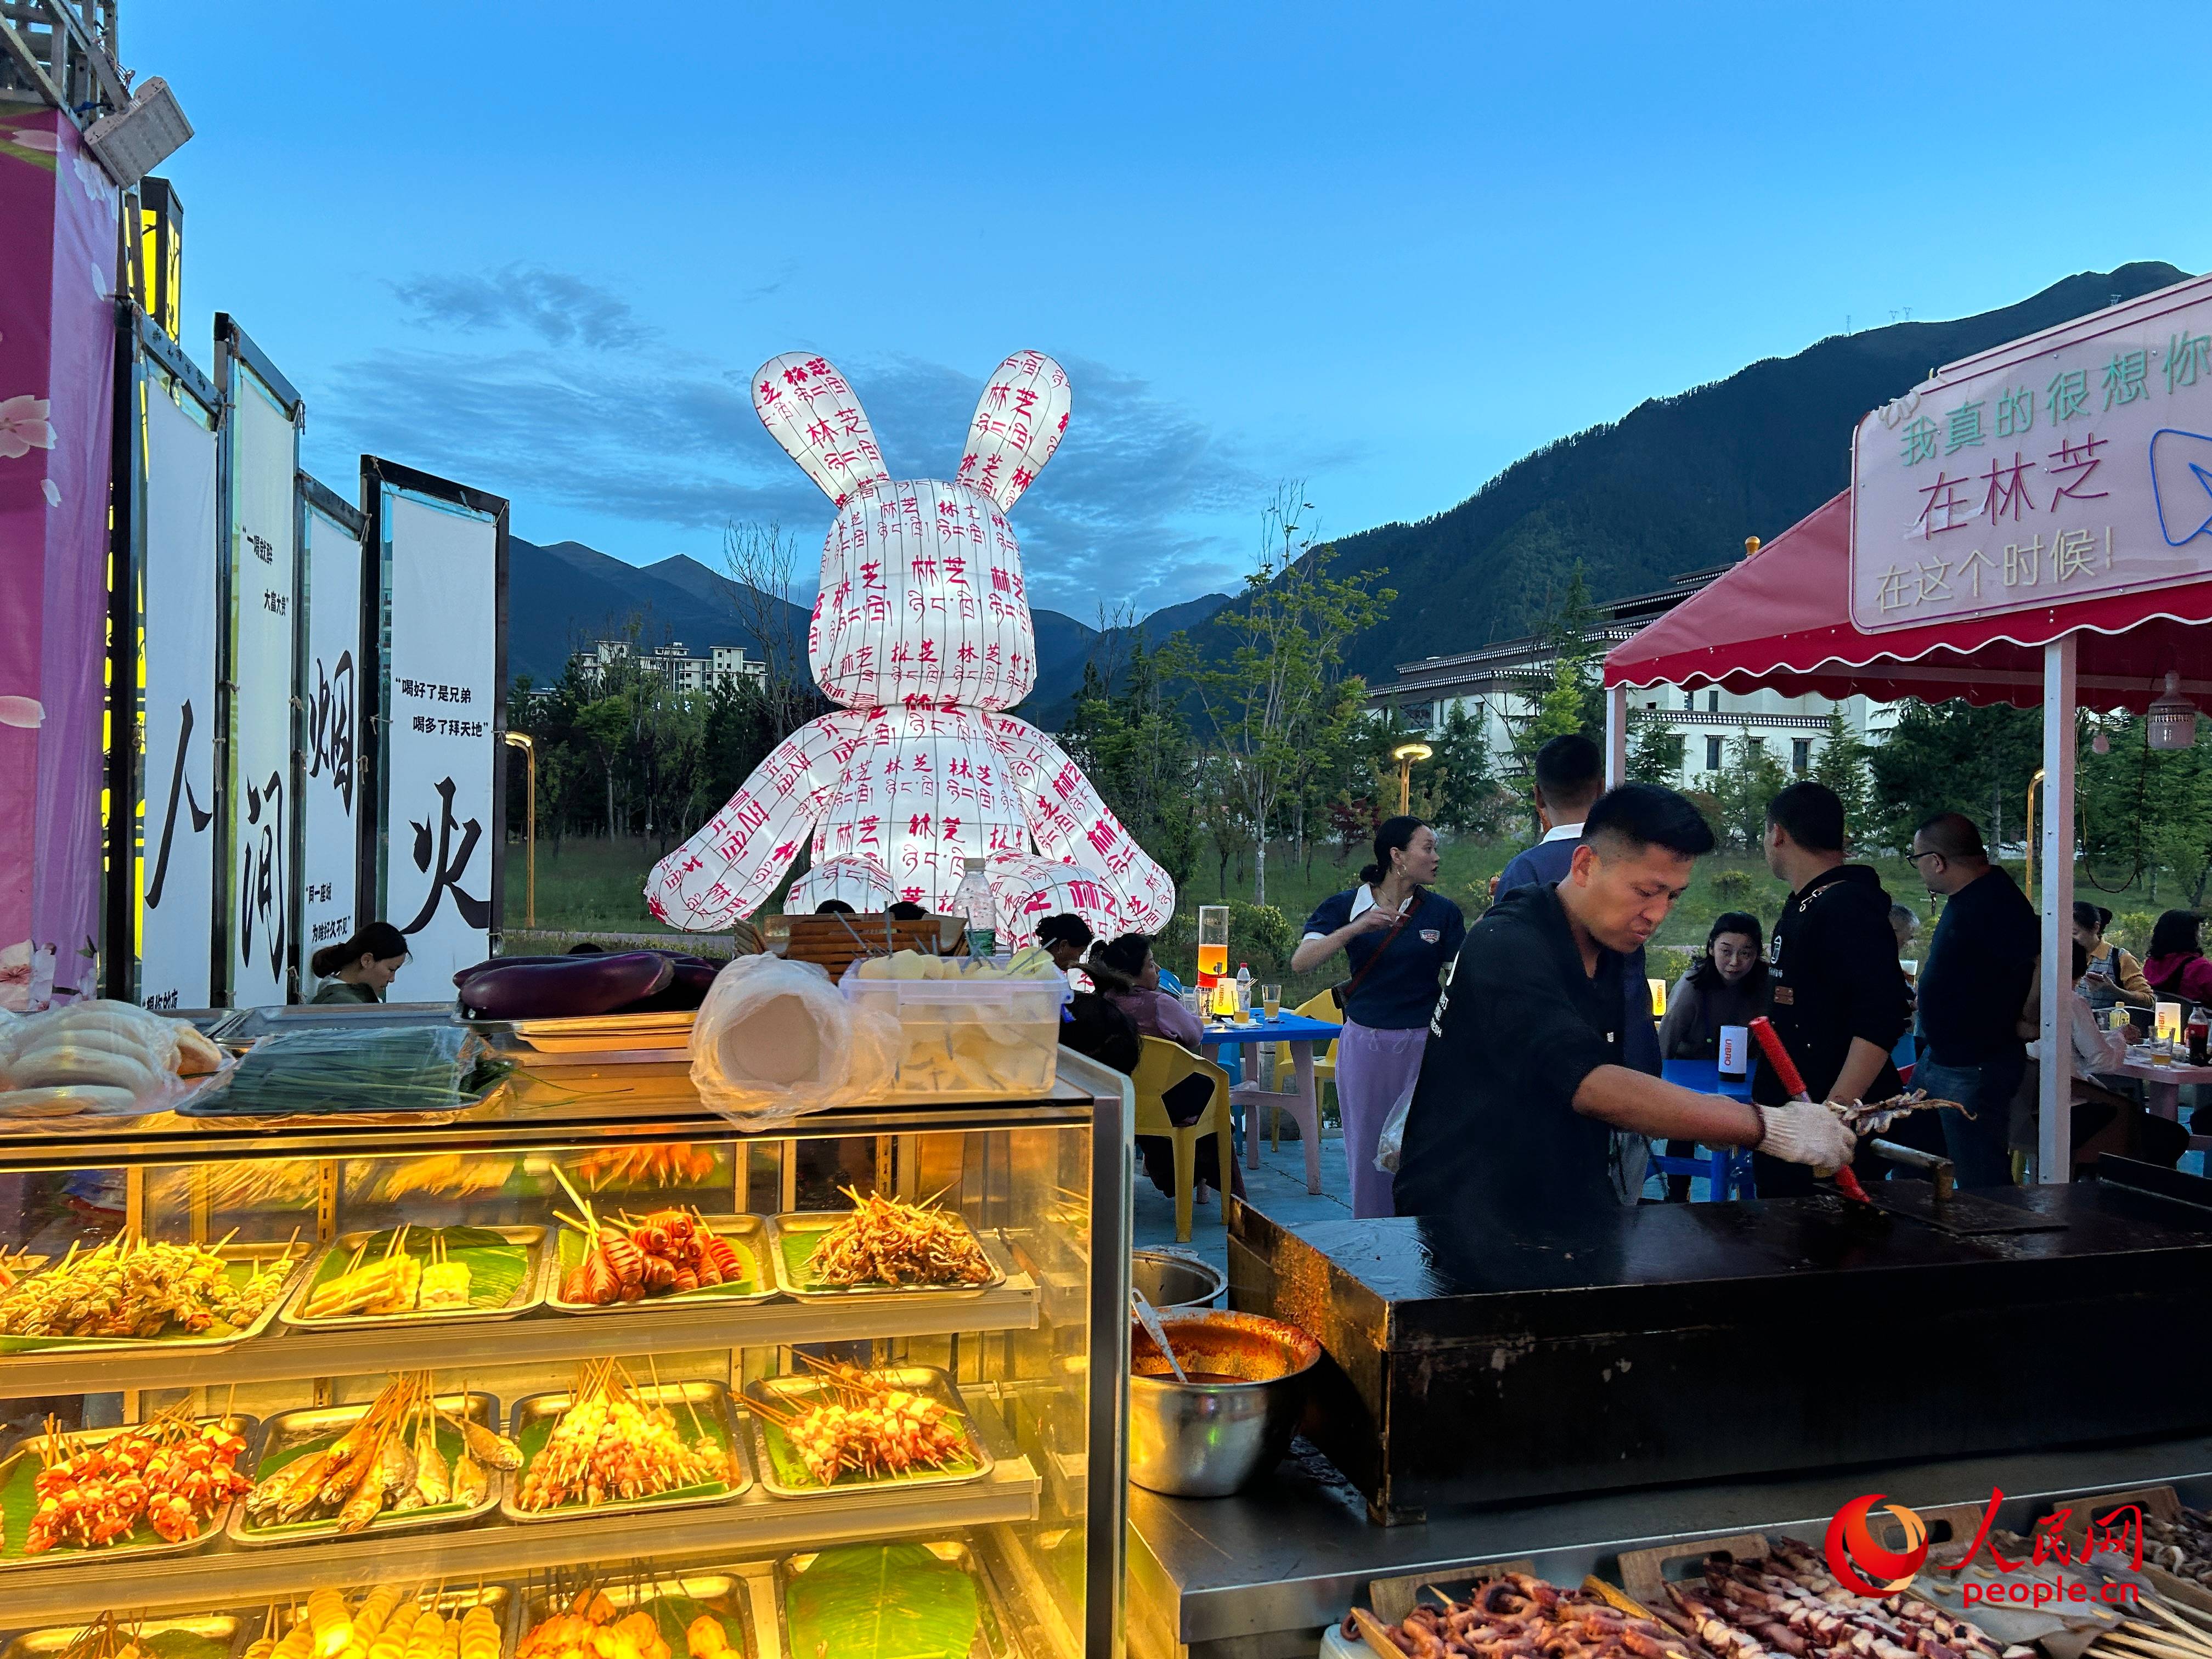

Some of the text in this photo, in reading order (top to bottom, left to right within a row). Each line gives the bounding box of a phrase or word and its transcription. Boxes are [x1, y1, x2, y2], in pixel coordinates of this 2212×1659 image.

[986, 382, 1039, 426] 林芝
[1900, 330, 2212, 466] 我真的很想你
[806, 408, 868, 448] 林芝
[1919, 432, 2108, 540] 在林芝
[881, 497, 919, 519] 林芝
[912, 555, 970, 591] 林芝
[891, 638, 938, 663] 林芝
[957, 640, 1002, 665] 林芝
[396, 677, 471, 703] “喝好了是兄弟
[413, 715, 488, 737] 喝多了拜天地”
[884, 753, 934, 775] 林芝
[949, 757, 994, 786] 林芝
[836, 815, 881, 851] 林芝
[909, 812, 966, 843] 林芝
[399, 776, 490, 934] 火
